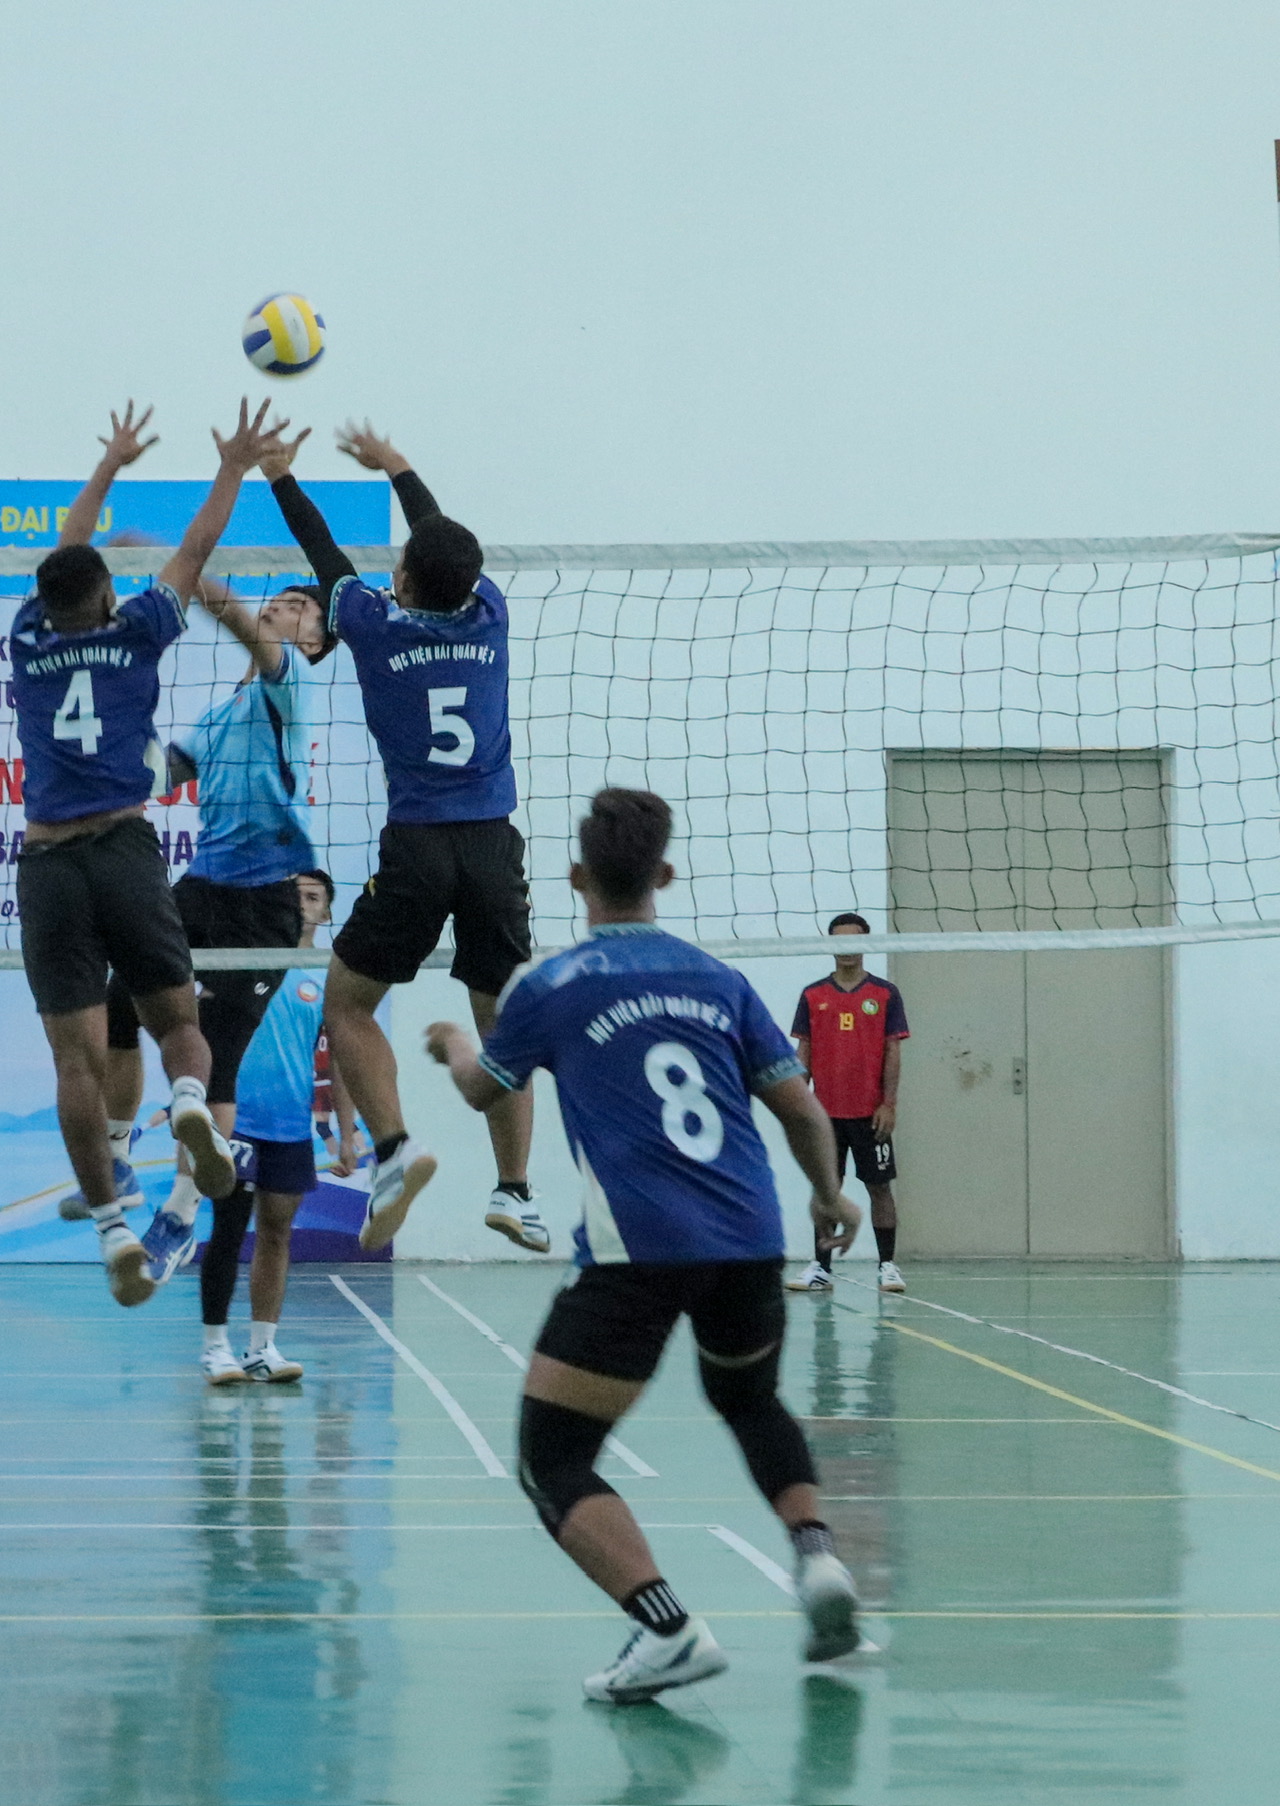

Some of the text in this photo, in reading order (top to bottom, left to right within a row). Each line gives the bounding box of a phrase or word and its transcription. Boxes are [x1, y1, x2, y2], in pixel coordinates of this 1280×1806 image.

[0, 506, 48, 540] ĐẠI
[53, 669, 103, 755] 4
[427, 686, 475, 766] 5
[839, 1013, 854, 1031] 19
[644, 1042, 724, 1163] 8
[875, 1143, 890, 1163] 19
